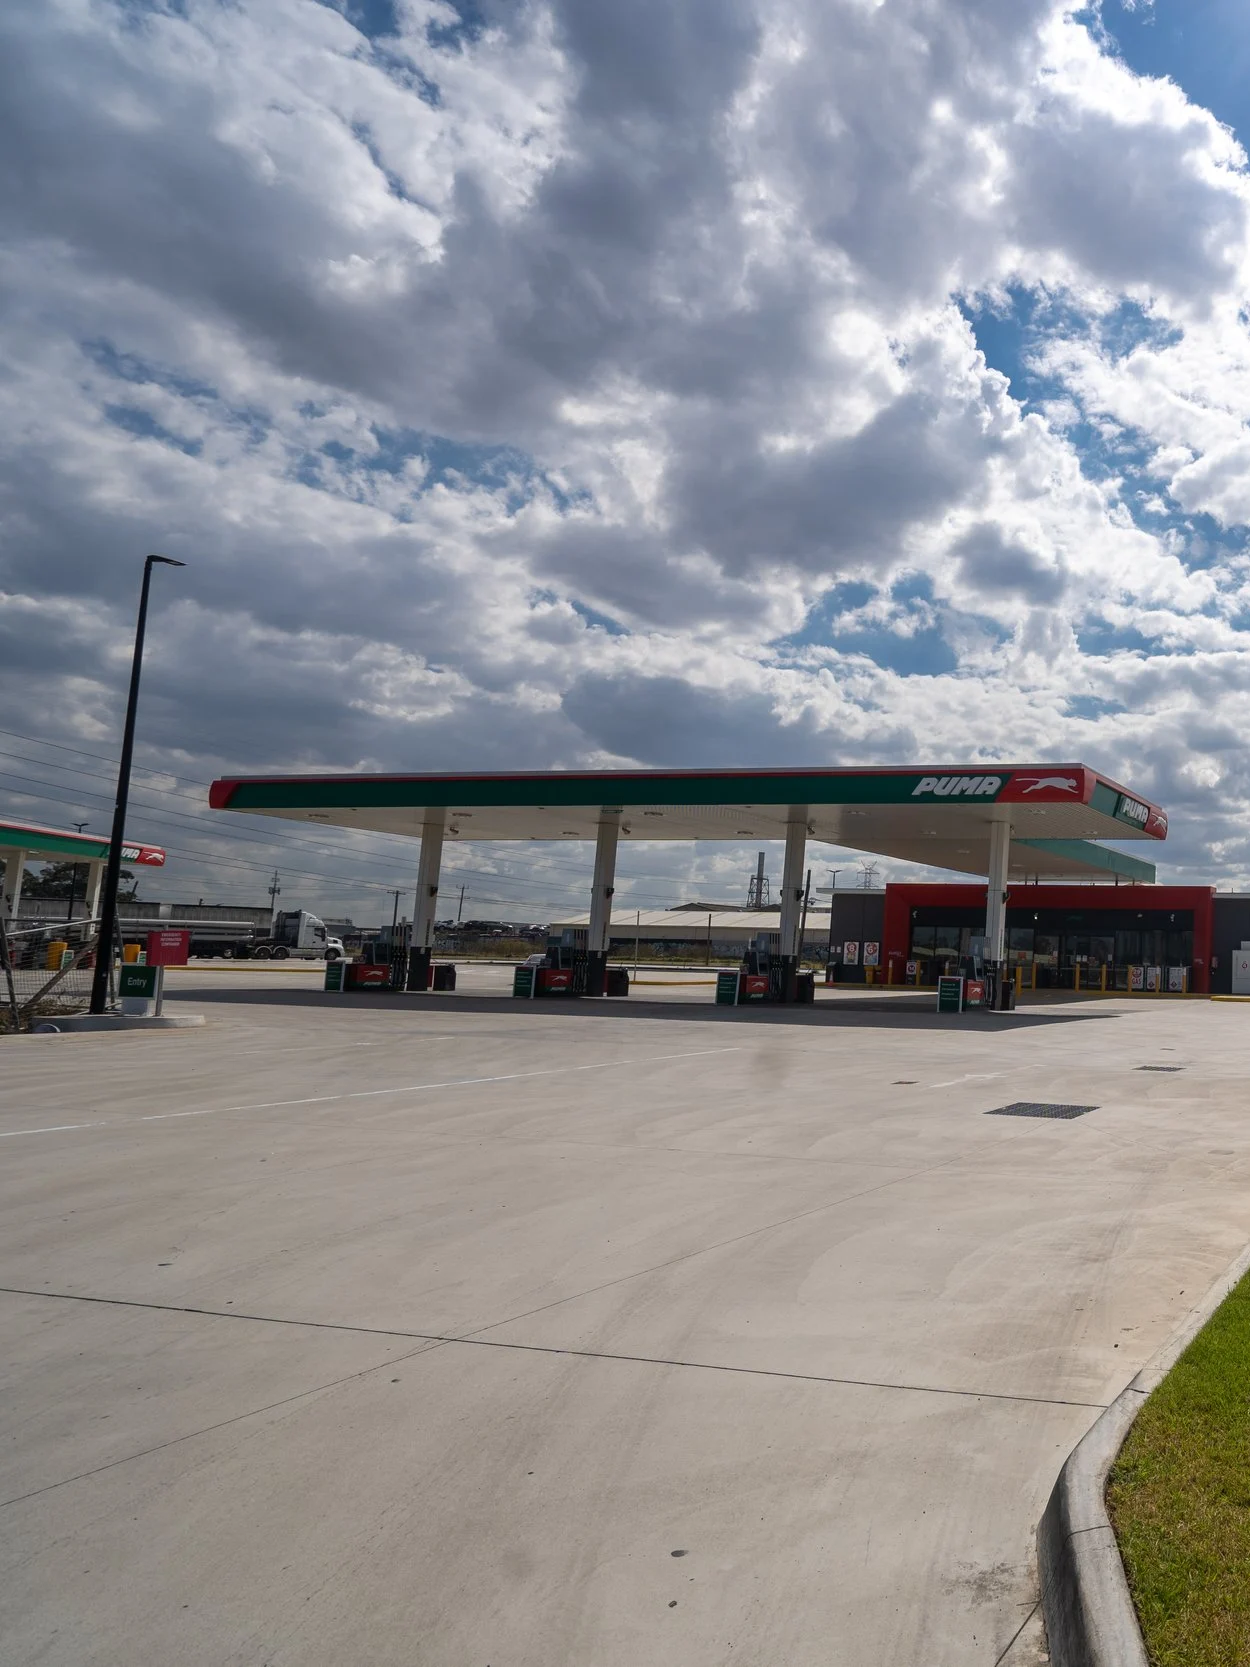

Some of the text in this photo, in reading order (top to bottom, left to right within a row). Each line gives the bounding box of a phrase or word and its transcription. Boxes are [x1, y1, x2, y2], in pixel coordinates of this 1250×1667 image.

[911, 776, 1003, 796] PUMA
[1121, 796, 1149, 824] PUMA
[127, 977, 148, 988] Entry
